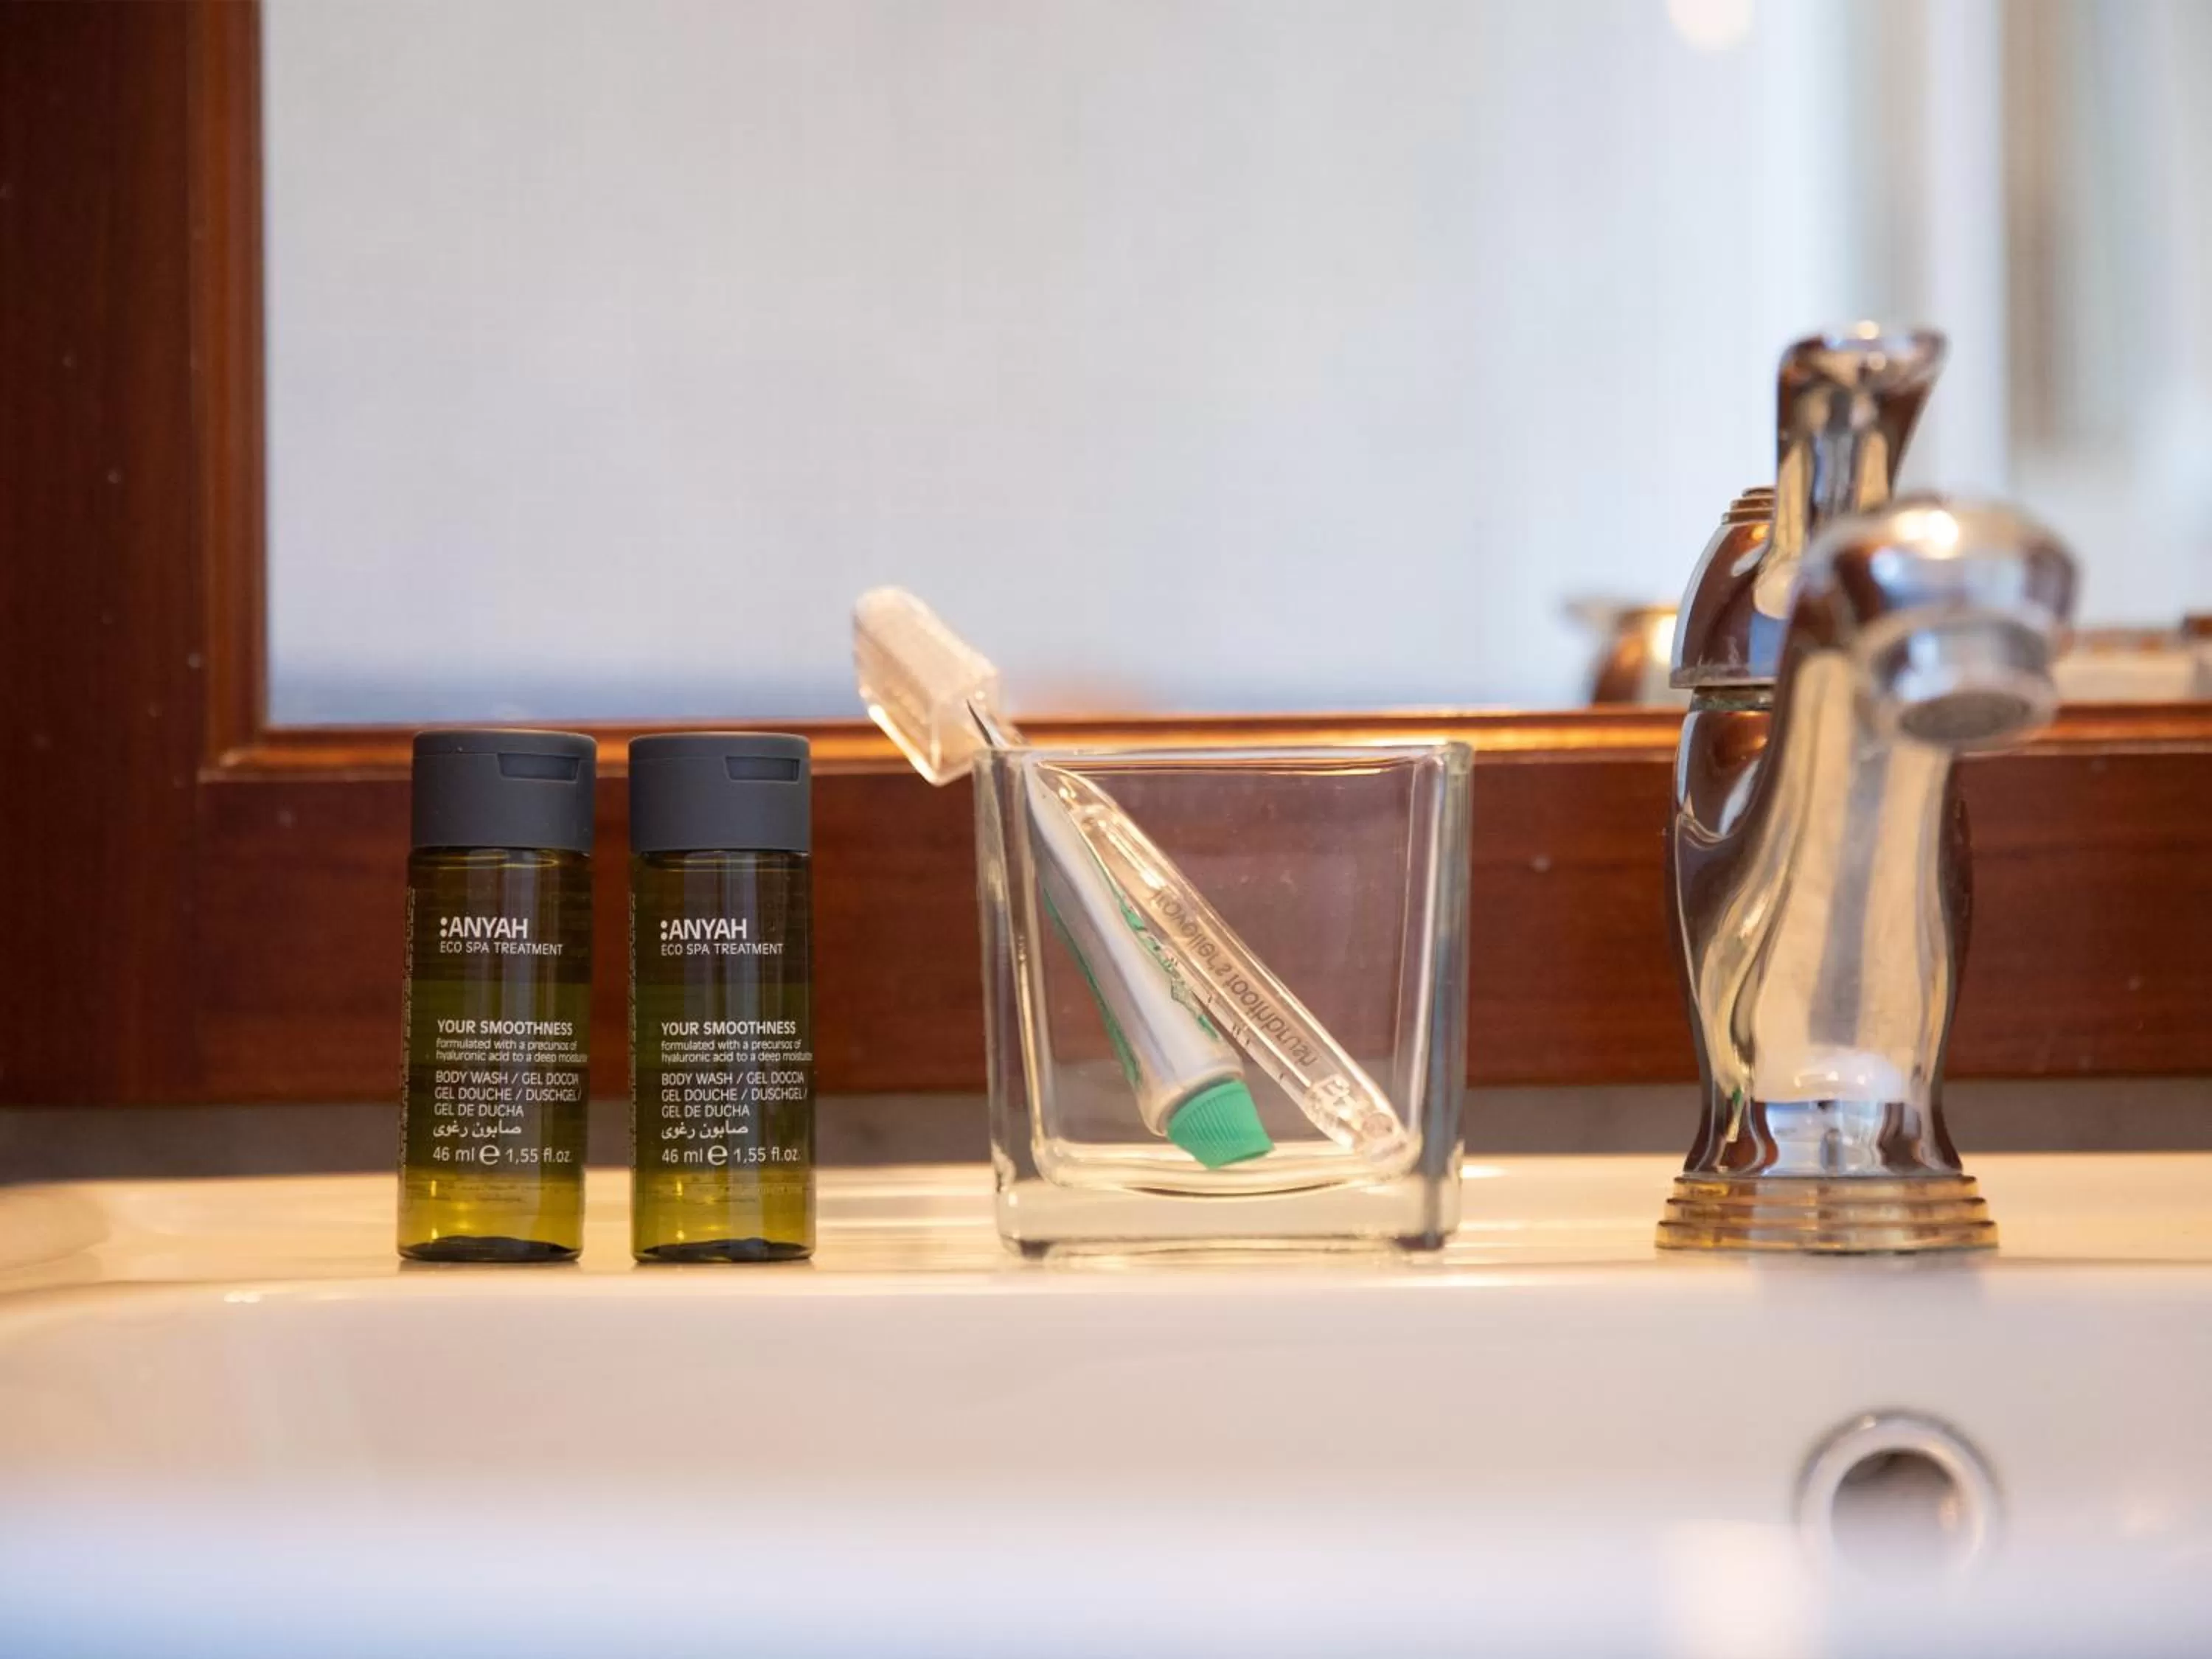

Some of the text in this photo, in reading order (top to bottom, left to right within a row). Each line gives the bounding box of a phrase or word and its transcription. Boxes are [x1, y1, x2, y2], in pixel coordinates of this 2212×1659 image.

[440, 941, 563, 955] ECO SPA TREATMENT
[661, 943, 784, 956] ECO SPA TREATMENT
[438, 1020, 573, 1036] YOUR SMOOTHNESS
[661, 1021, 796, 1036] YOUR SMOOTHNESS
[436, 1037, 577, 1052] formulated with a precursor of
[661, 1039, 801, 1051] formulated with a precursor of
[437, 1051, 487, 1062] hyaluronic
[488, 1051, 509, 1062] acid
[512, 1052, 524, 1062] to
[526, 1054, 532, 1062] a
[534, 1053, 556, 1063] deep
[661, 1051, 710, 1065] hyaluronic
[713, 1051, 734, 1062] acid
[737, 1051, 748, 1062] to
[750, 1054, 756, 1062] a
[758, 1052, 781, 1062] deep
[436, 1071, 467, 1083] BODY
[470, 1072, 508, 1084] WASH
[522, 1073, 543, 1085] GEL
[661, 1073, 692, 1085] BODY
[696, 1072, 732, 1084] WASH
[746, 1072, 767, 1084] GEL
[771, 1071, 804, 1083] DOCCIA
[435, 1087, 454, 1099] GEL
[458, 1088, 512, 1101] DOUCHE
[526, 1089, 577, 1102] DUSCHGEL
[662, 1089, 681, 1102] GEL
[684, 1088, 737, 1102] DOUCHE
[751, 1088, 803, 1101] DUSCHGEL
[434, 1104, 524, 1117] GEL DE DUCHA
[662, 1104, 750, 1118] GEL DE DUCHA
[472, 1120, 521, 1138] صابون
[700, 1119, 749, 1138] صابون
[433, 1147, 450, 1161] 46
[455, 1147, 475, 1161] ml
[507, 1149, 538, 1164] 1,55
[662, 1149, 678, 1163] 46
[684, 1148, 703, 1163] ml
[734, 1147, 766, 1163] 1,55
